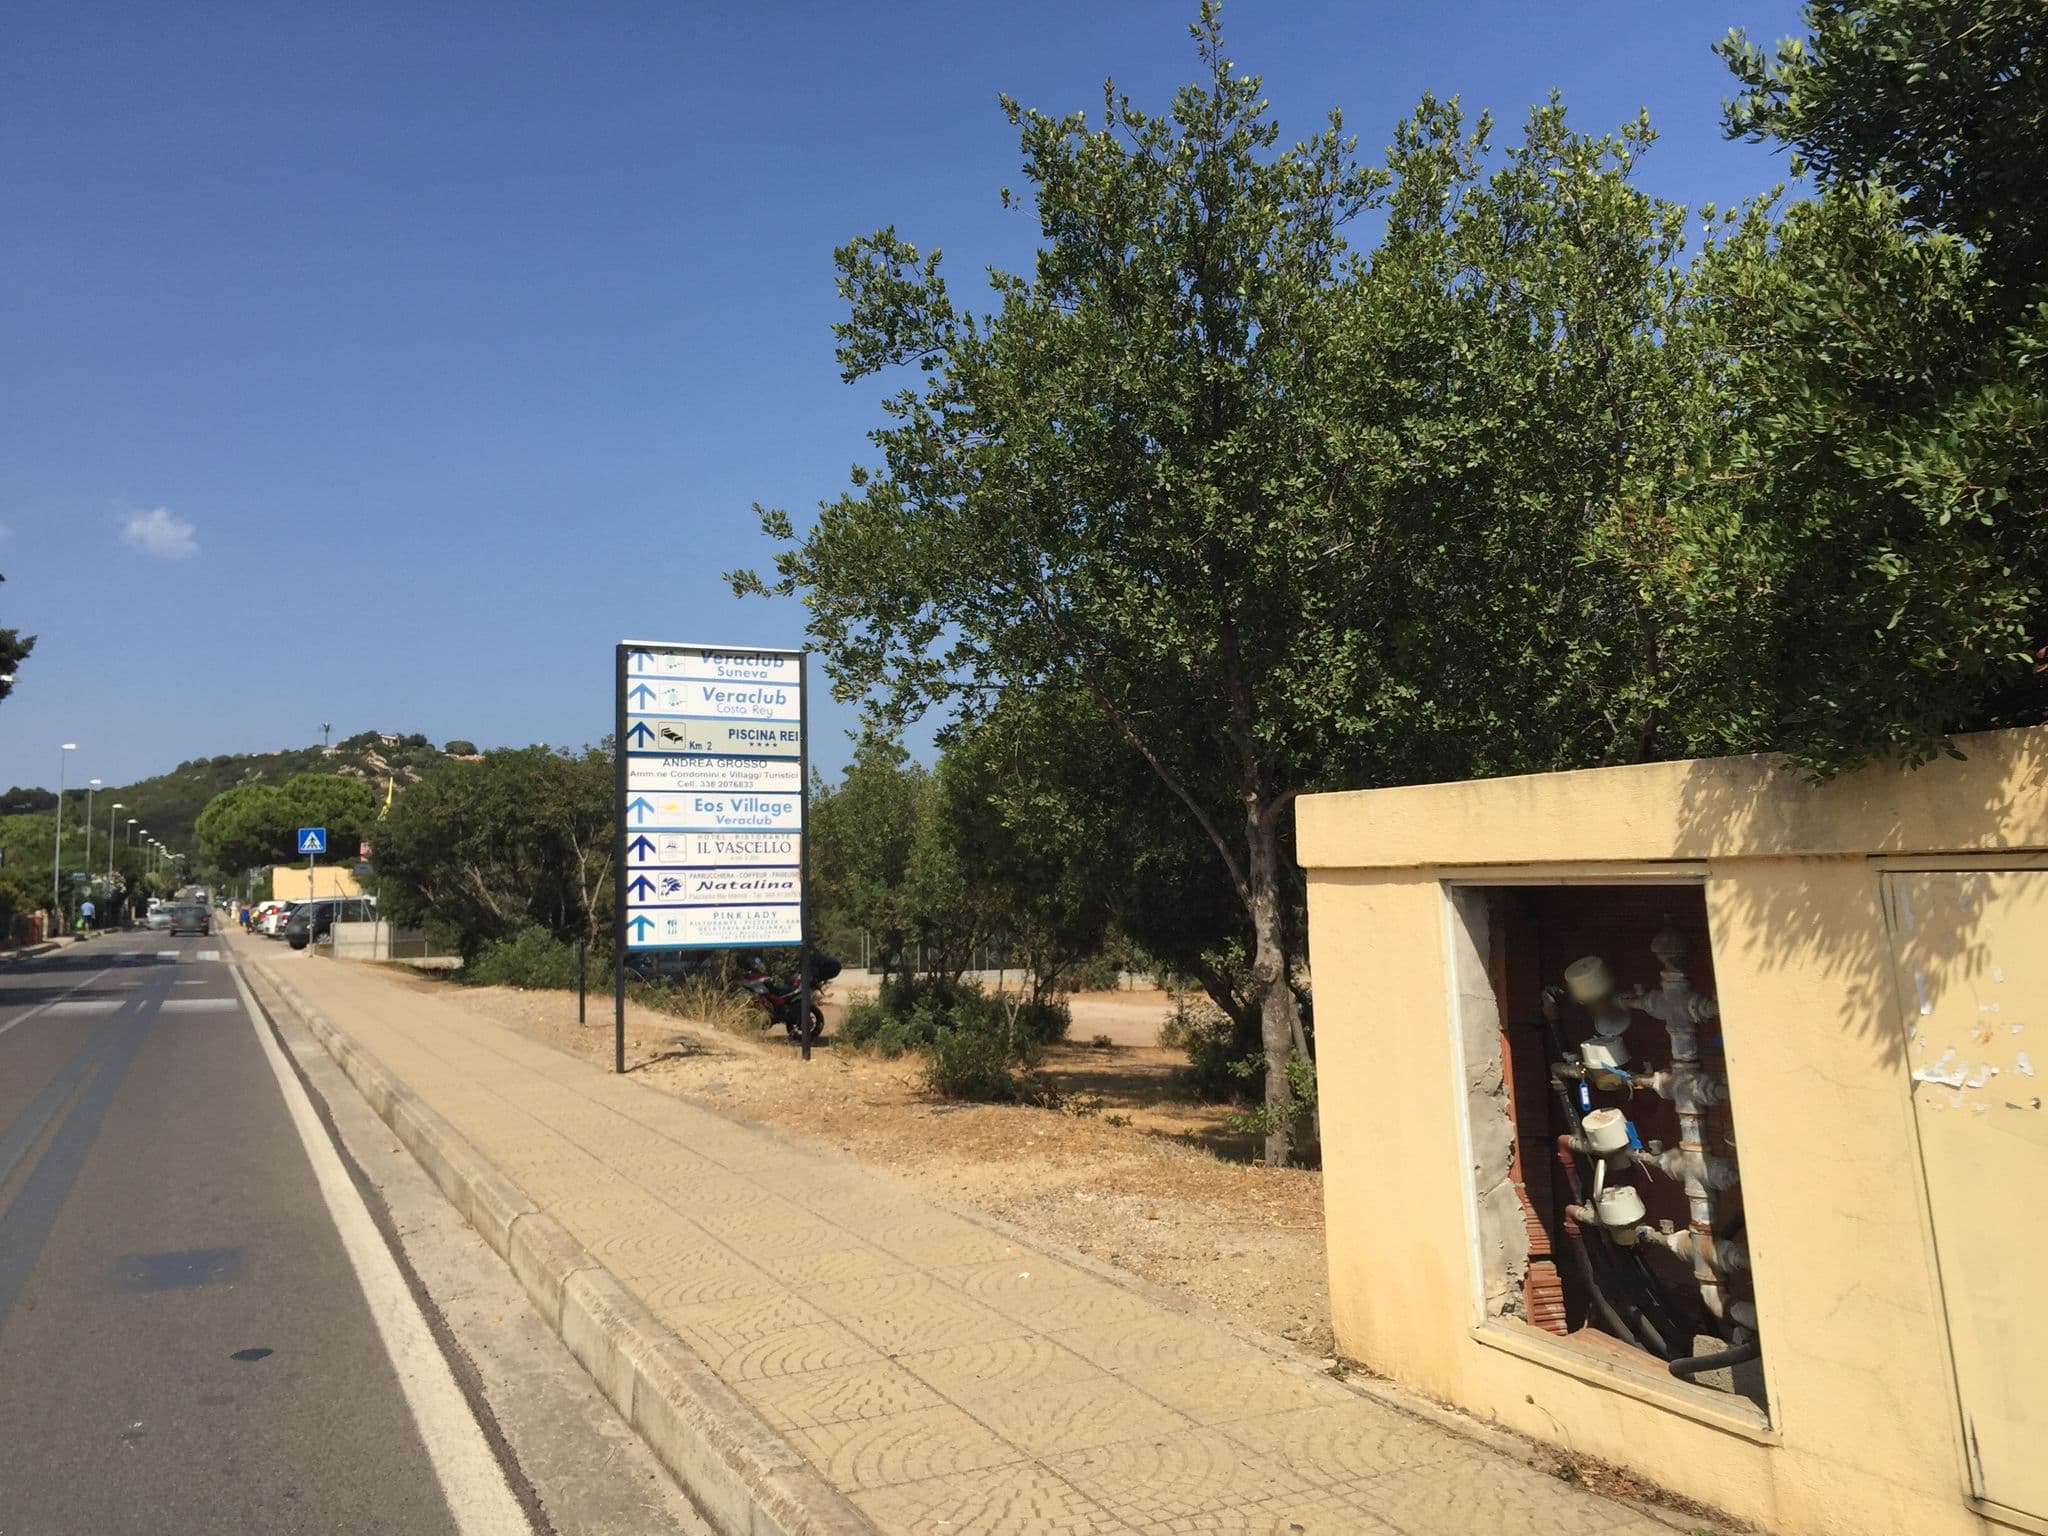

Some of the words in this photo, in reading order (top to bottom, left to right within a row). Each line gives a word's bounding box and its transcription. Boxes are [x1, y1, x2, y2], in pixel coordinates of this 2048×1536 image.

[700, 650, 785, 668] Veraclub
[717, 666, 768, 679] Suneva
[702, 686, 787, 705] Veraclub
[716, 703, 747, 714] Costa
[752, 705, 774, 719] Rey
[728, 728, 776, 741] PISCINA
[780, 730, 799, 742] REI
[689, 741, 703, 751] Km
[706, 741, 713, 751] 2
[662, 757, 714, 768] ANDREA
[717, 759, 768, 769] GROSSO
[729, 771, 762, 780] Villaggi
[764, 771, 799, 779] Turistici
[694, 798, 724, 813] Eos
[730, 798, 793, 817] Village
[716, 815, 773, 826] Veraclub
[697, 841, 711, 854] IL
[715, 841, 792, 854] VASCELLO
[696, 879, 794, 892] Natalina
[713, 912, 743, 920] PINK
[747, 911, 777, 919] LADY
